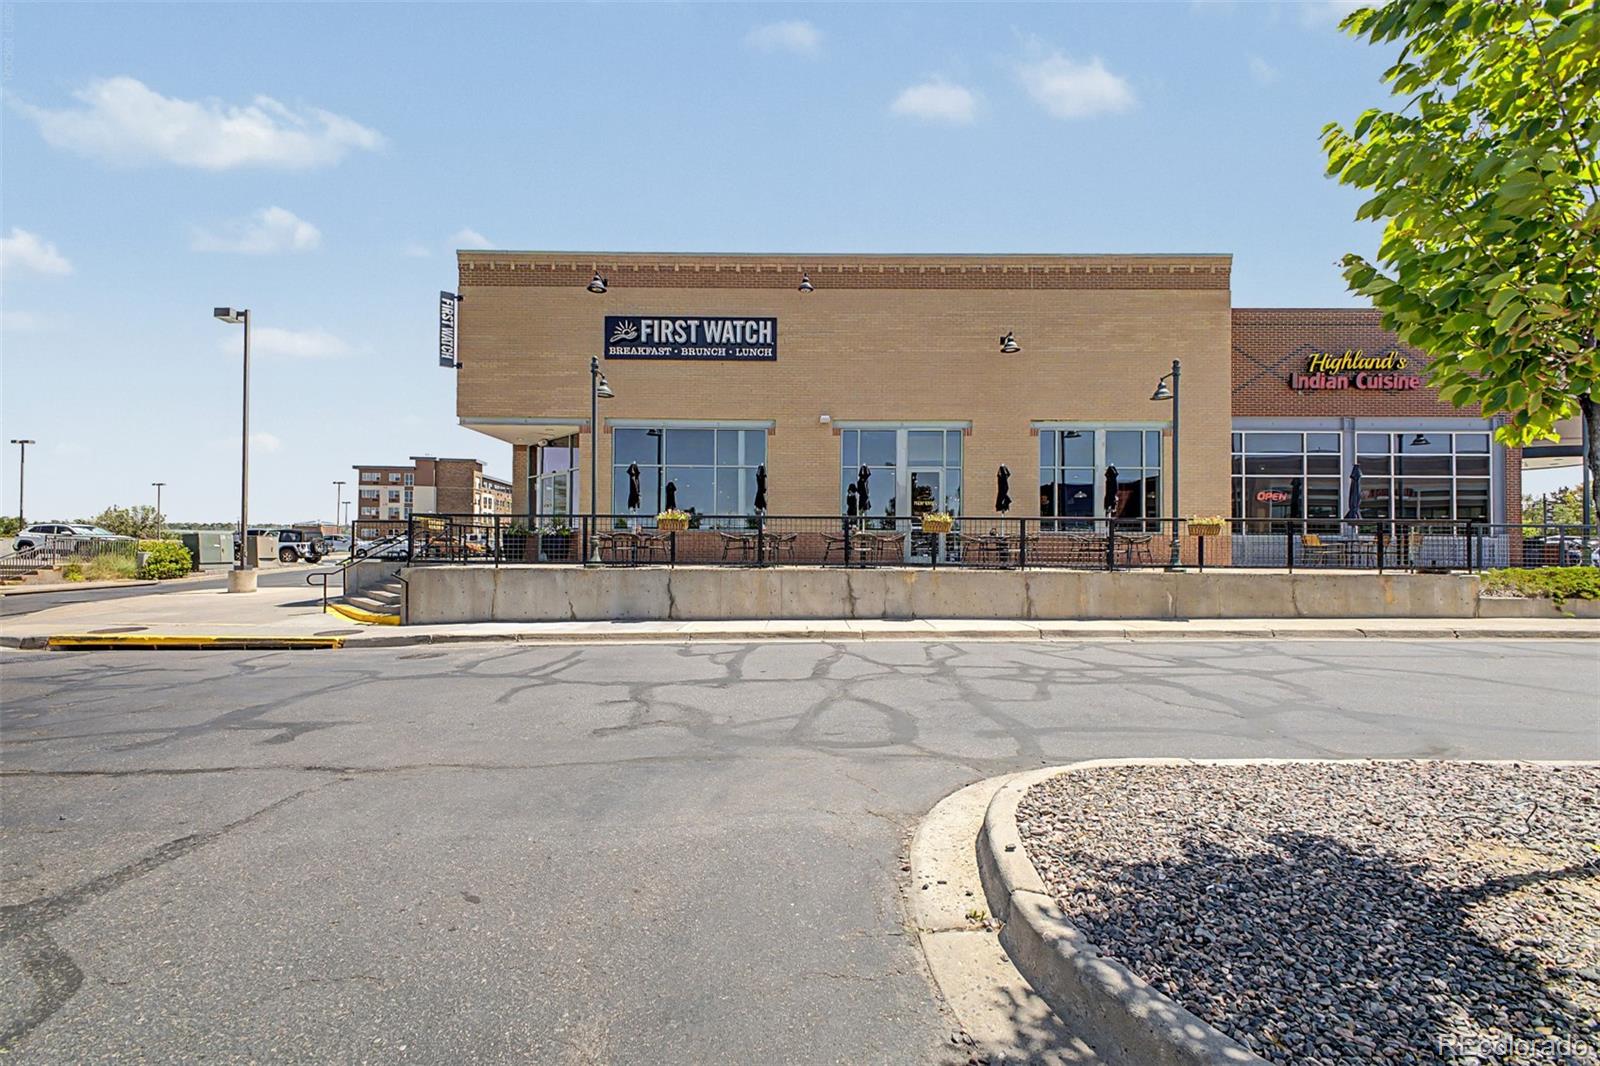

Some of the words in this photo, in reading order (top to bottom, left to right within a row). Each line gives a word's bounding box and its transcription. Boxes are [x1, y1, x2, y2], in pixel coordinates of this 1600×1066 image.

[441, 298, 454, 327] FIRST
[441, 327, 454, 359] WATCH
[640, 319, 700, 344] FIRST
[703, 320, 773, 345] WATCH
[609, 347, 672, 356] BREAKFAST
[681, 347, 726, 357] BRUNCH
[735, 348, 773, 357] LUNCH
[1308, 350, 1408, 375] Highland's
[1291, 373, 1350, 390] Indian
[1355, 372, 1420, 390] Cuisine
[1256, 491, 1288, 501] OPEN
